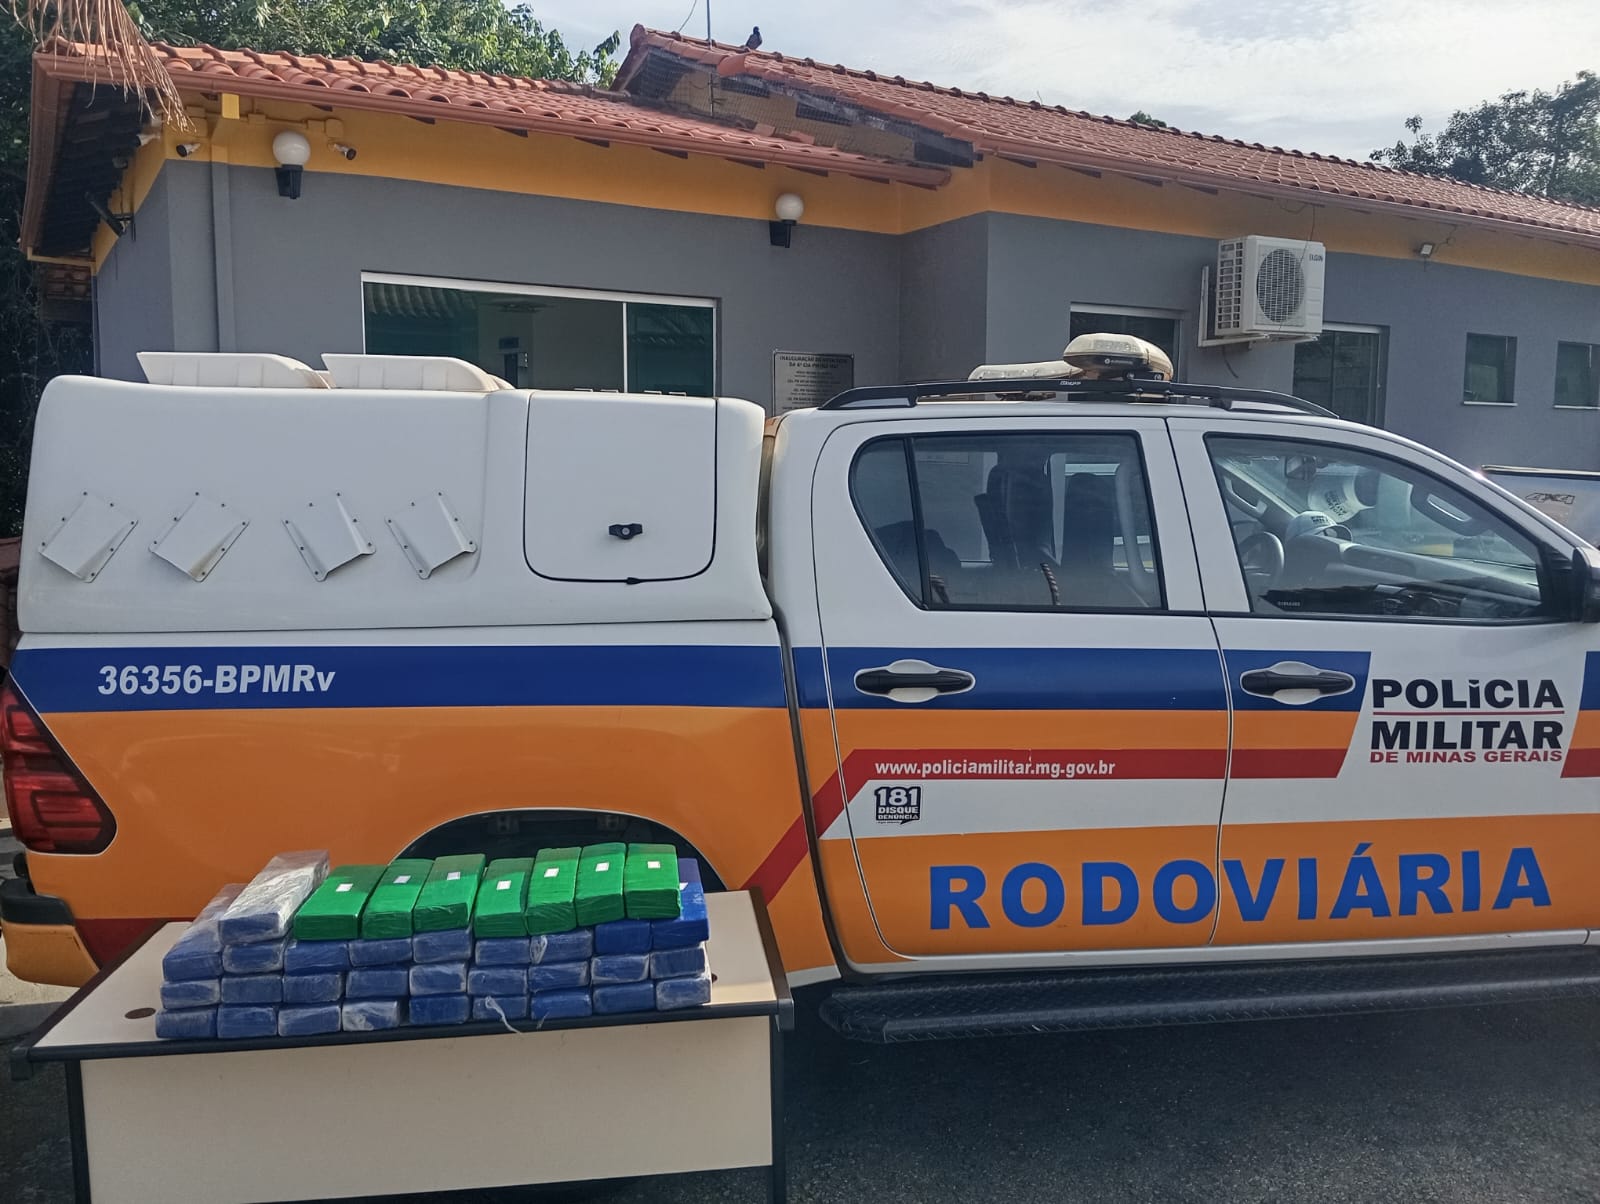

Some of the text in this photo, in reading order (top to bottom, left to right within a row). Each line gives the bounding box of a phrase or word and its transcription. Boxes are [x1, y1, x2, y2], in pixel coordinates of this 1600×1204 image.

[97, 664, 336, 695] 36356-BPMRv
[1370, 720, 1564, 750] MILITAR
[1370, 750, 1563, 763] DE MINAS GERAIS
[875, 759, 1115, 778] www.policiamilitar.mg.gov.br
[878, 788, 918, 806] 181
[878, 806, 919, 814] DISQUE
[929, 843, 1552, 930] RODOVIÁRIA
